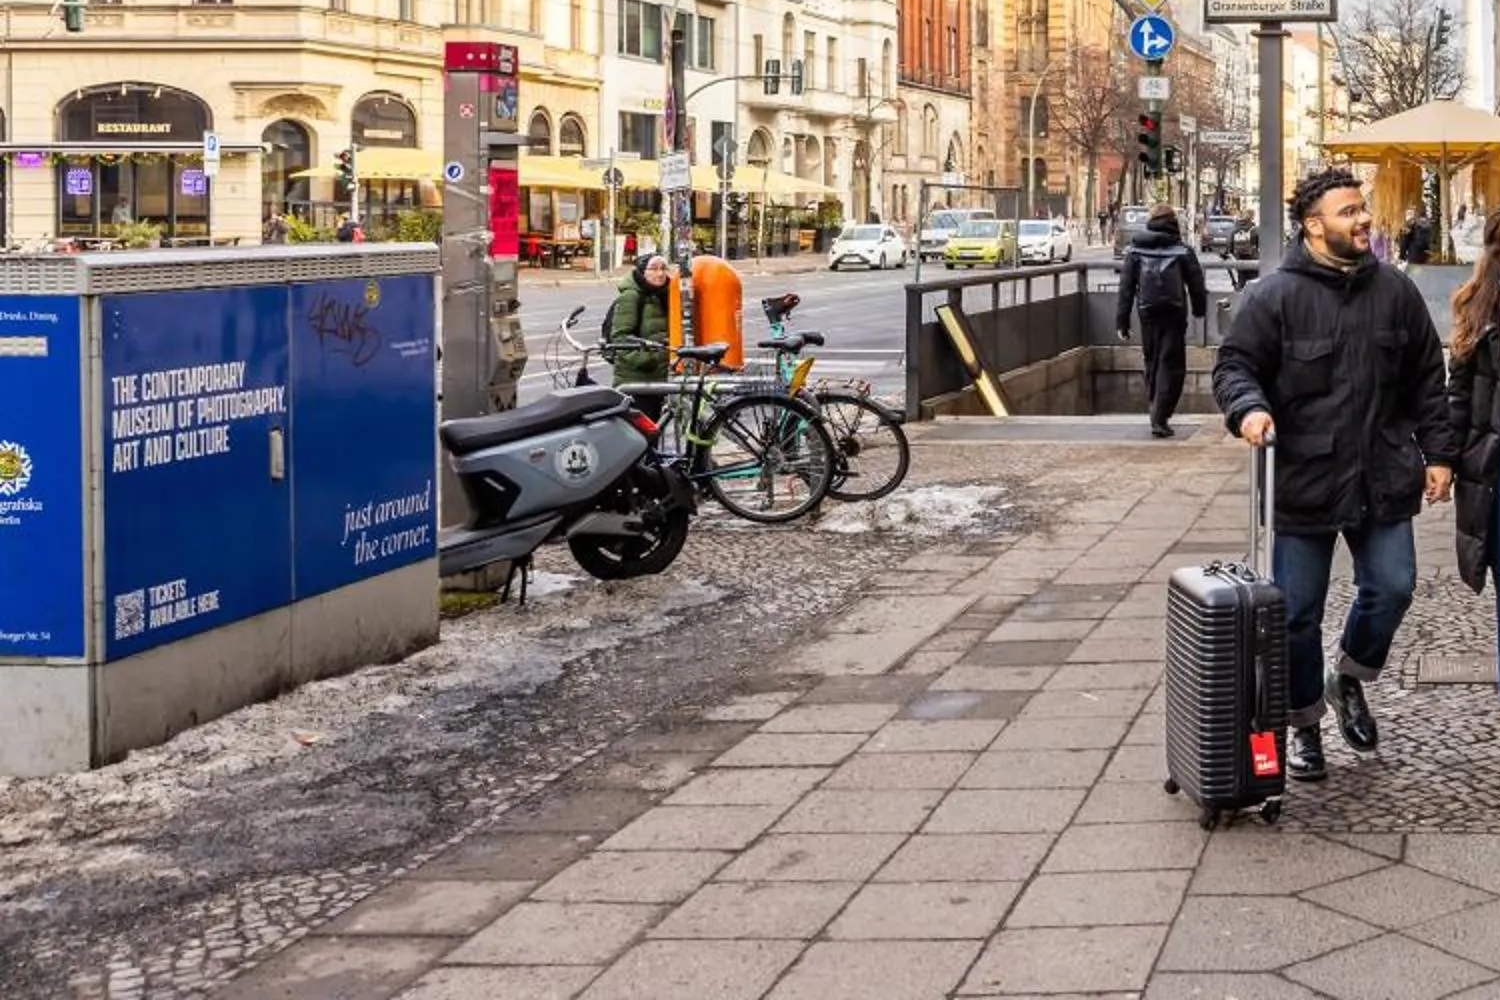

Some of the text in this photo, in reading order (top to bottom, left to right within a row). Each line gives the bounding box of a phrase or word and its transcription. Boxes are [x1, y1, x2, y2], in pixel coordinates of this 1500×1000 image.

[1290, 0, 1326, 12] Straße
[97, 123, 172, 133] RESTAURANT
[112, 361, 246, 406] THE CONTEMPORARY
[112, 402, 175, 440] MUSEUM
[177, 399, 195, 429] OF
[112, 425, 231, 473] ART AND CULTURE
[341, 479, 431, 548] just around
[354, 523, 431, 566] the corner.
[149, 579, 187, 607] TICKETS
[149, 597, 197, 629] AVAILABLE
